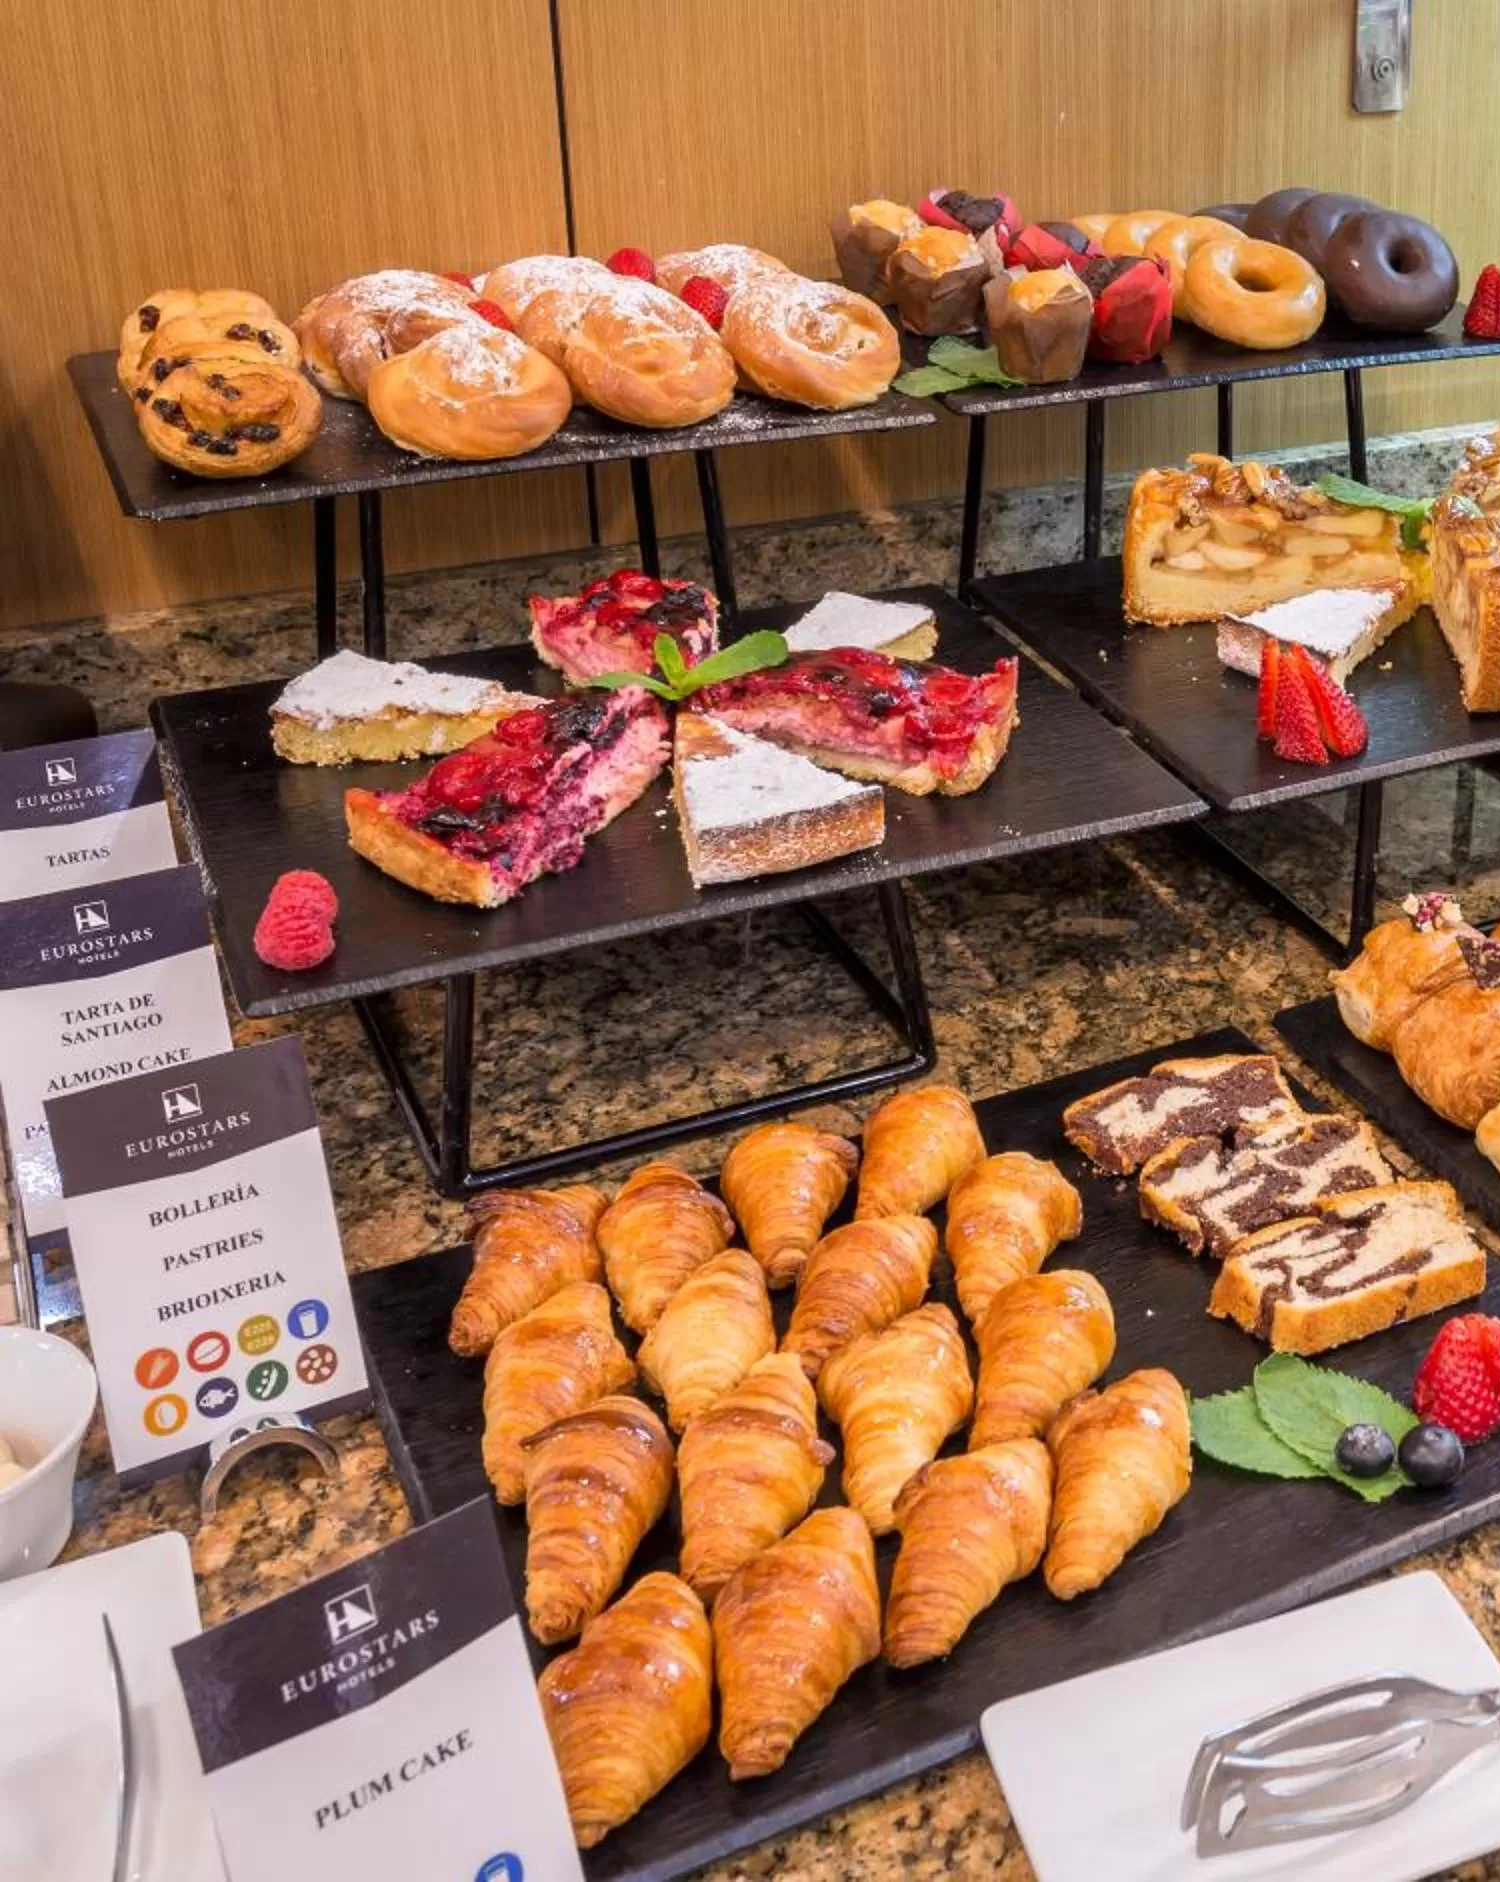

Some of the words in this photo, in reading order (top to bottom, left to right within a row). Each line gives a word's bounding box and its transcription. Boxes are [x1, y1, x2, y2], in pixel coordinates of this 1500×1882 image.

[16, 782, 115, 810] EUROSTARS
[46, 846, 111, 868] TARTAS
[40, 927, 154, 961] EUROSTARS
[61, 997, 125, 1026] TARTA
[129, 992, 155, 1015] DE
[60, 1013, 164, 1047] SANTIAGO
[46, 1054, 134, 1094] ALMOND
[137, 1047, 192, 1073] CAKE
[124, 1111, 252, 1159] EUROSTARS
[162, 1229, 265, 1272] PASTRIES
[156, 1270, 288, 1324] BRIOIXERIA
[280, 1608, 441, 1704] EUROSTARS
[336, 1657, 397, 1693] HOTELS
[313, 1771, 394, 1831] PLUM
[400, 1728, 475, 1783] CAKE
